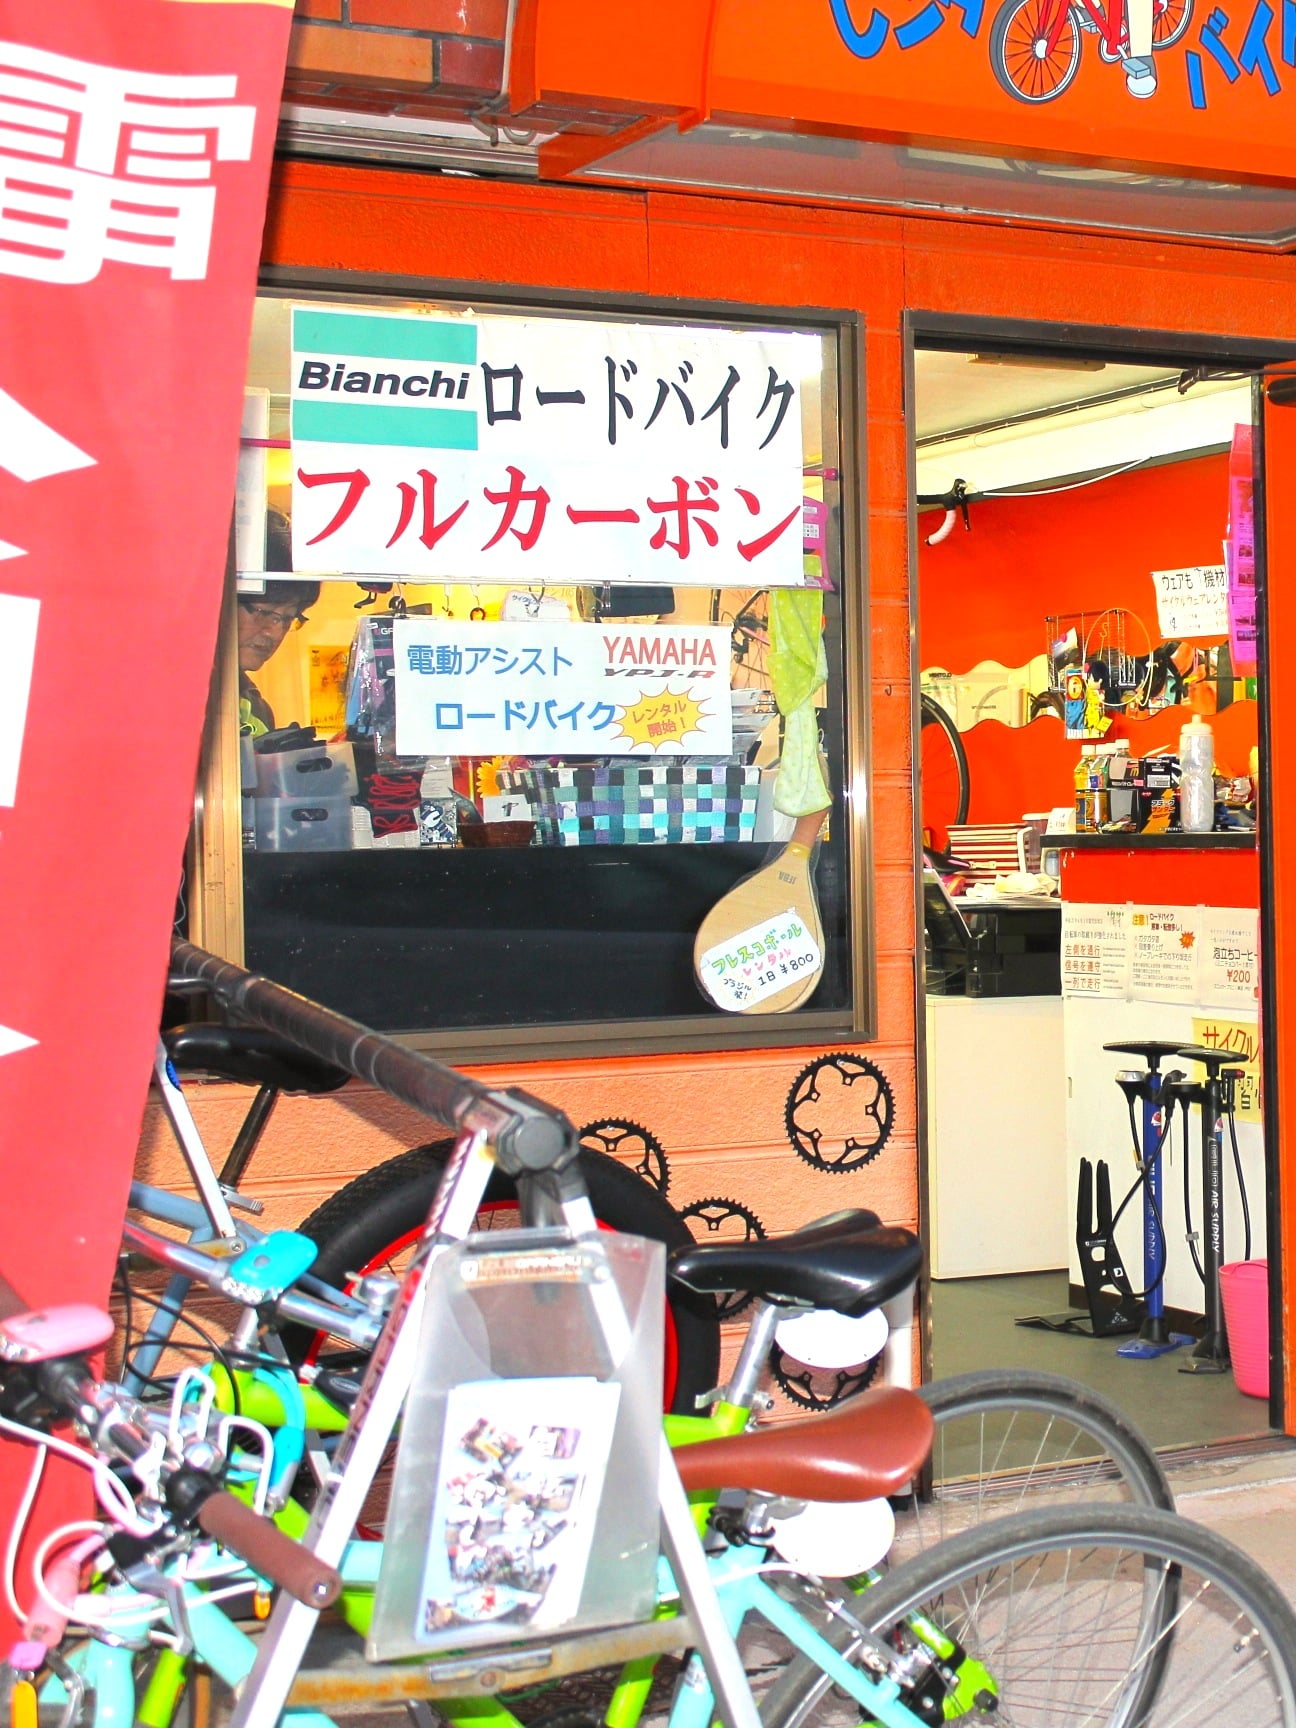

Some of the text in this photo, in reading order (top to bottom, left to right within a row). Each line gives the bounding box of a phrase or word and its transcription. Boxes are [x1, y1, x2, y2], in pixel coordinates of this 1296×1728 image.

[298, 361, 469, 400] Bianchi
[481, 355, 795, 450] ロードバイク
[297, 465, 801, 562] フルカーボン
[407, 644, 573, 676] 電動アシスト
[602, 636, 717, 666] YAMAHA
[602, 668, 717, 679] YPJ-R
[436, 699, 616, 731] ロードバイク
[632, 700, 687, 725] レンタル
[712, 923, 802, 976] フレスコボール
